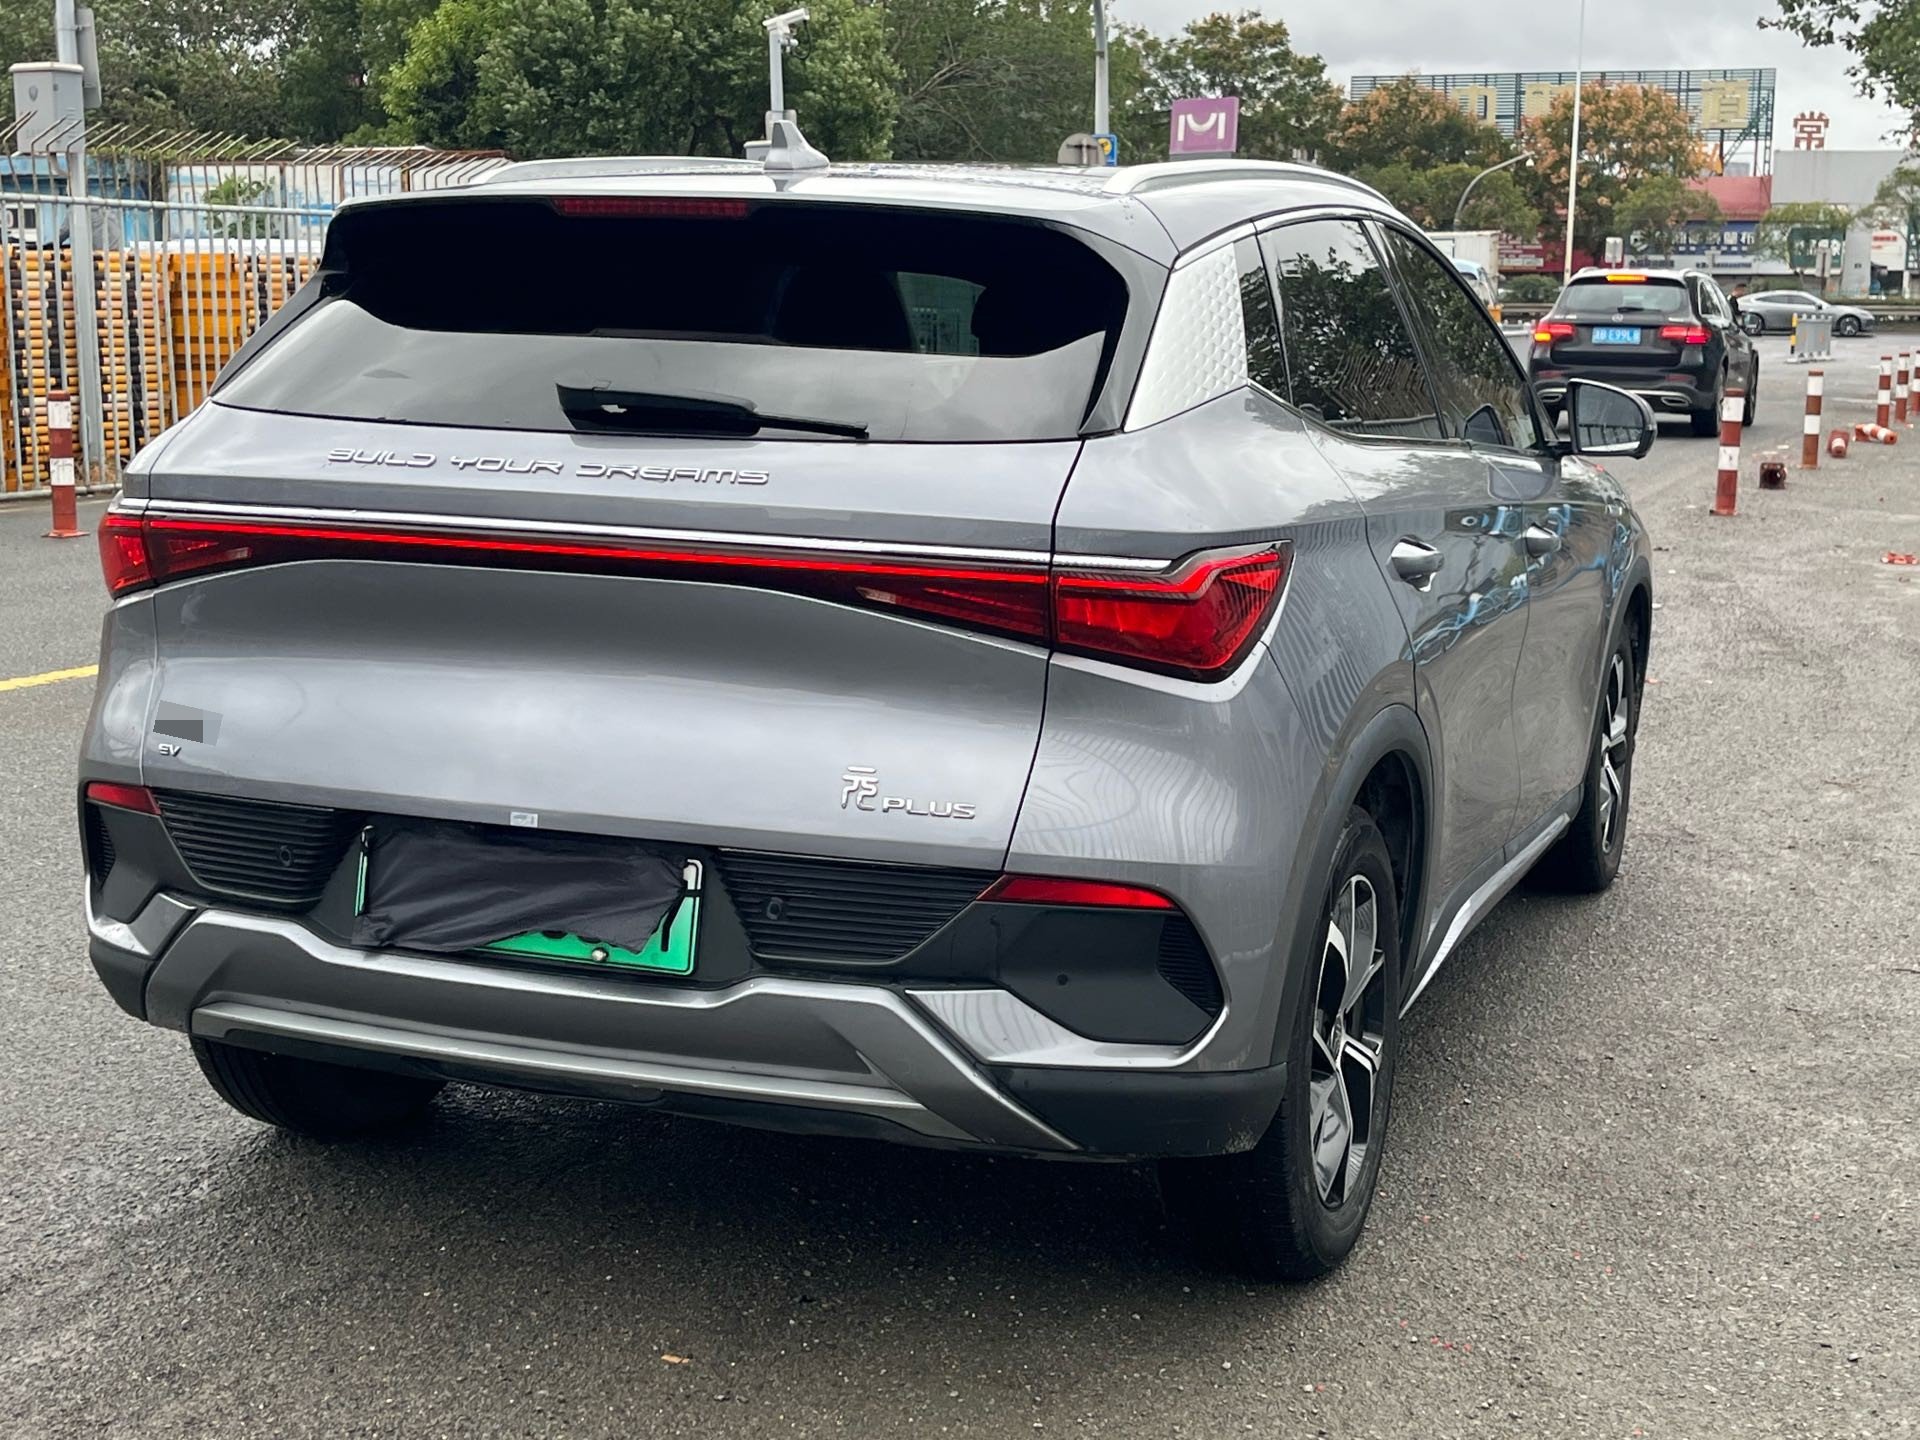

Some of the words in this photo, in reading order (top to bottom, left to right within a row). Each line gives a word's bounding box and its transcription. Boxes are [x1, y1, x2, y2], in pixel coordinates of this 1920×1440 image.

[1793, 111, 1829, 151] 常
[327, 447, 438, 467] BUILD
[450, 455, 566, 475] YOUR
[576, 463, 770, 485] DREAMS
[158, 743, 182, 757] EV
[840, 766, 879, 811] 元
[882, 797, 976, 819] PLUS
